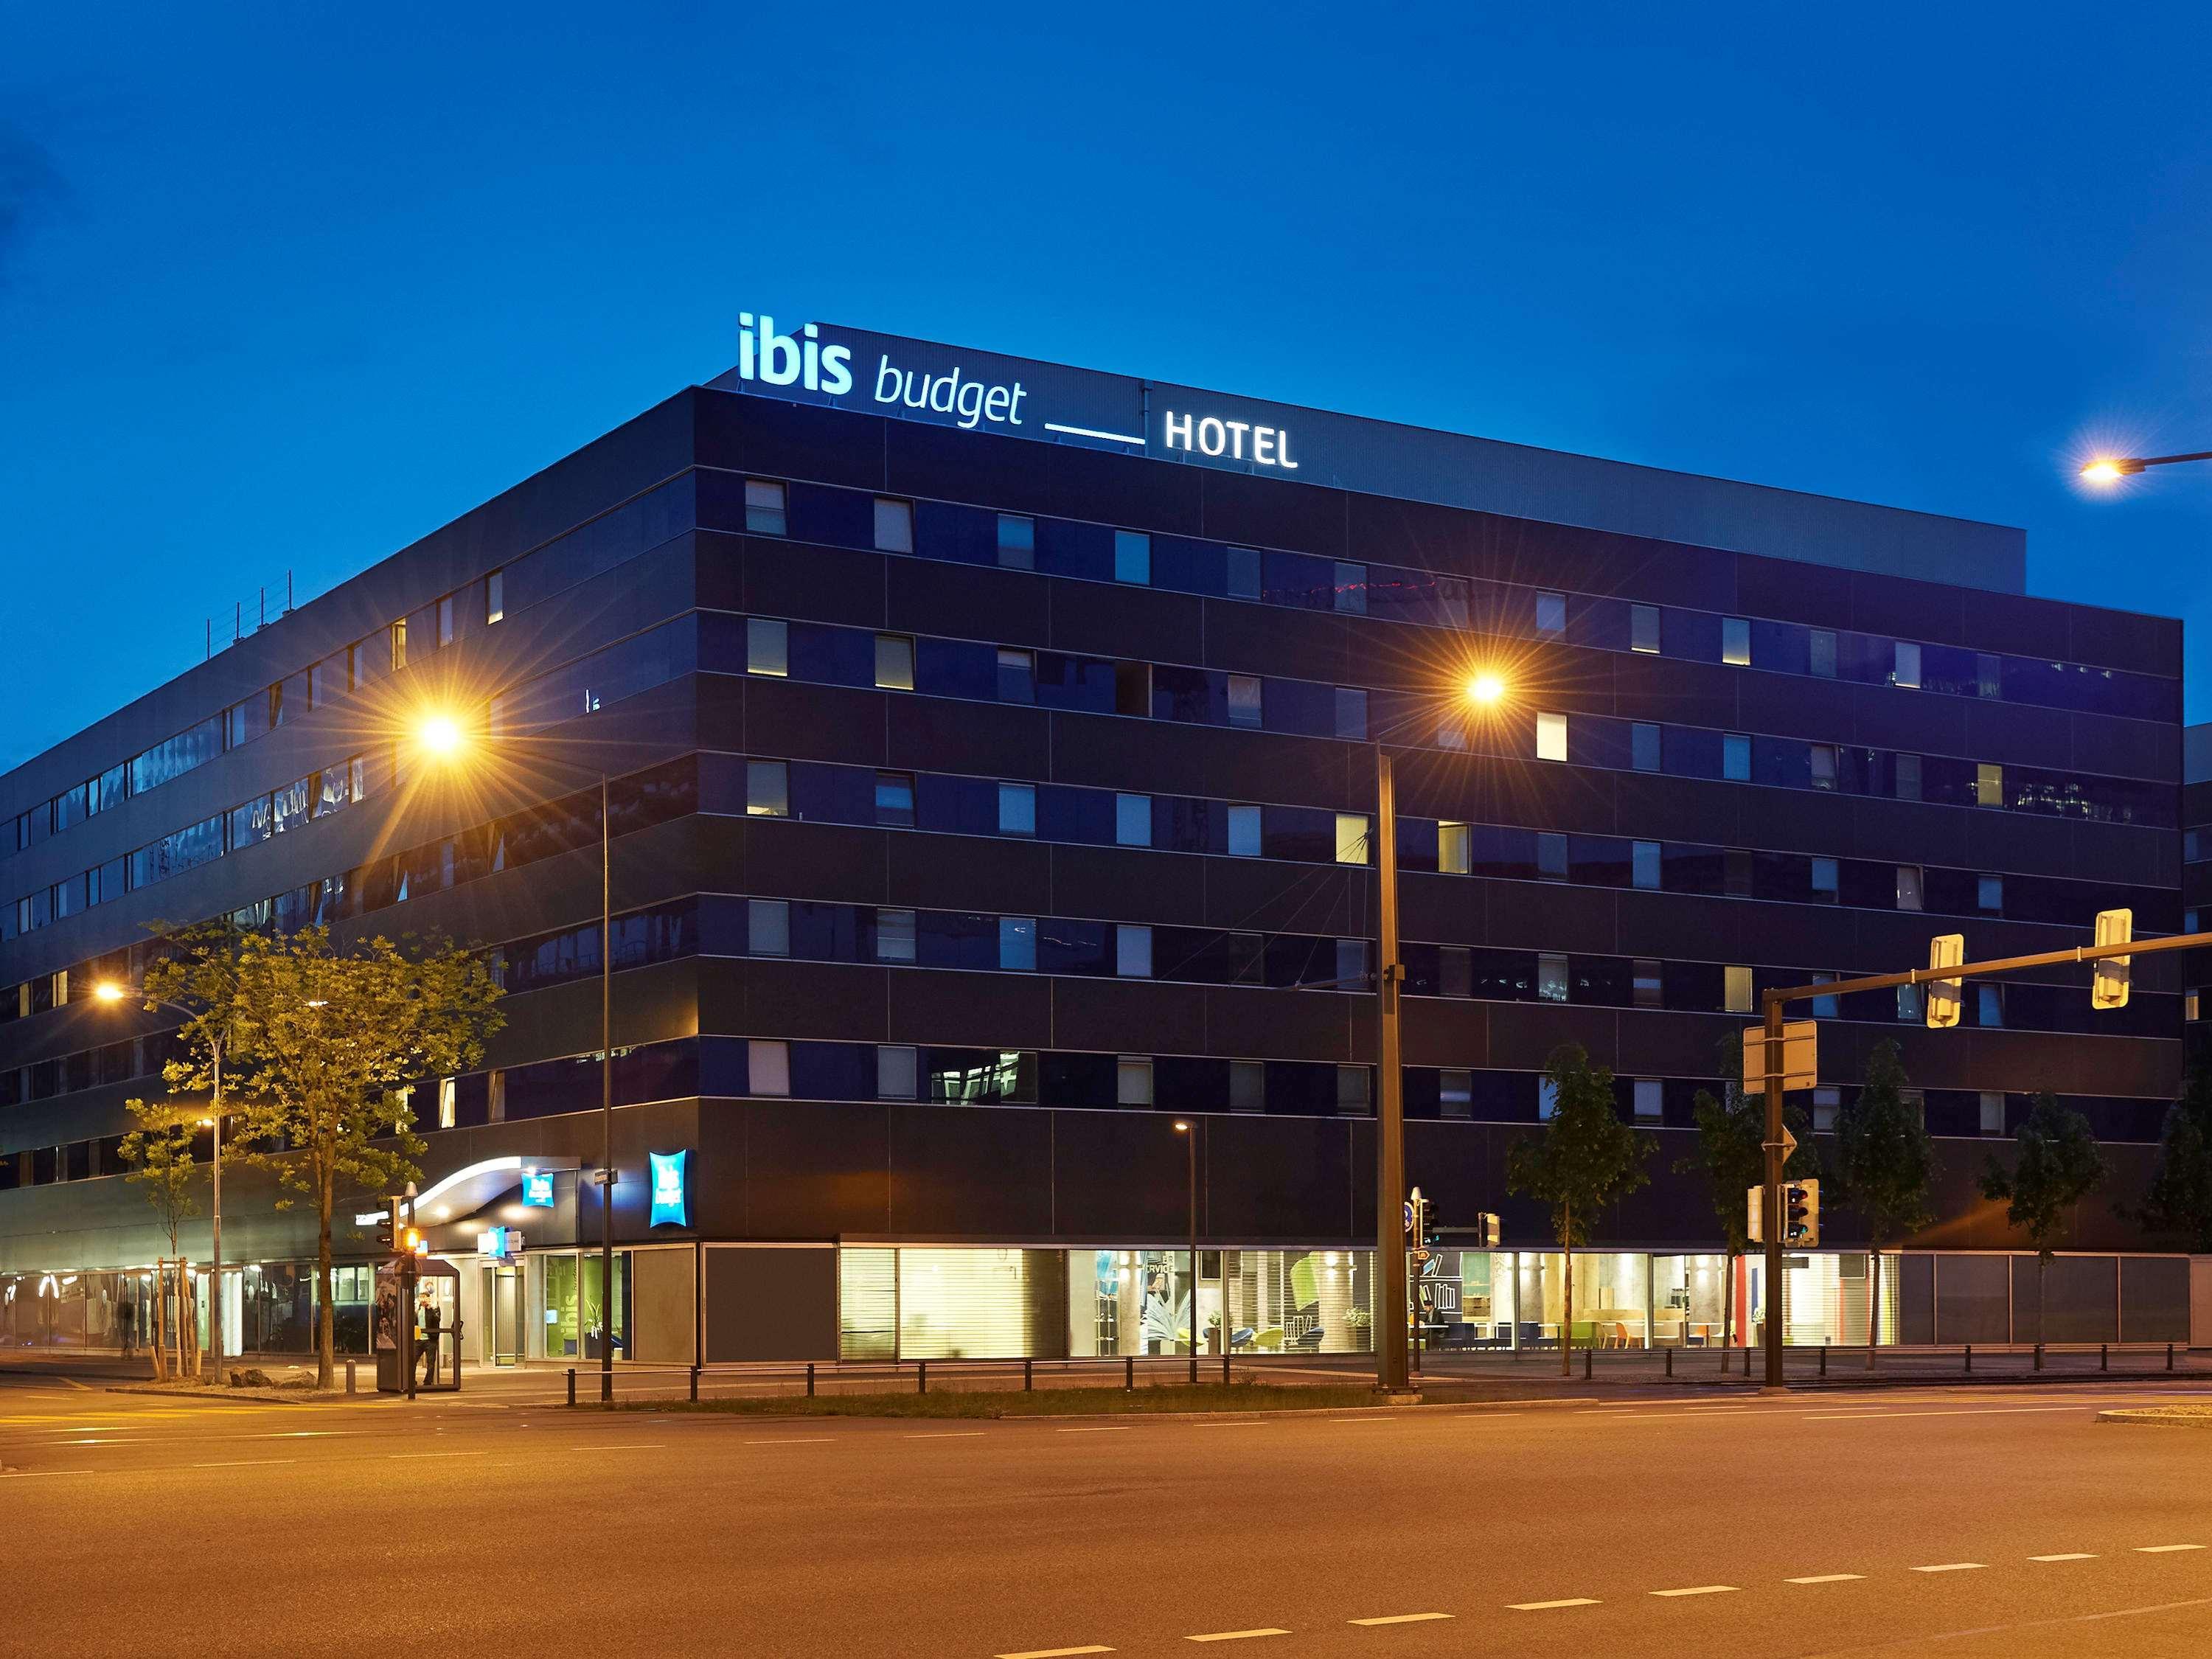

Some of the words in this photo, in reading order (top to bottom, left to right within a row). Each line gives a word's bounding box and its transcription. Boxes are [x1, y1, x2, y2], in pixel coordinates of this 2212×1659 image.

[740, 312, 852, 394] ibis
[874, 355, 1027, 428] budget
[1166, 411, 1298, 468] HOTEL
